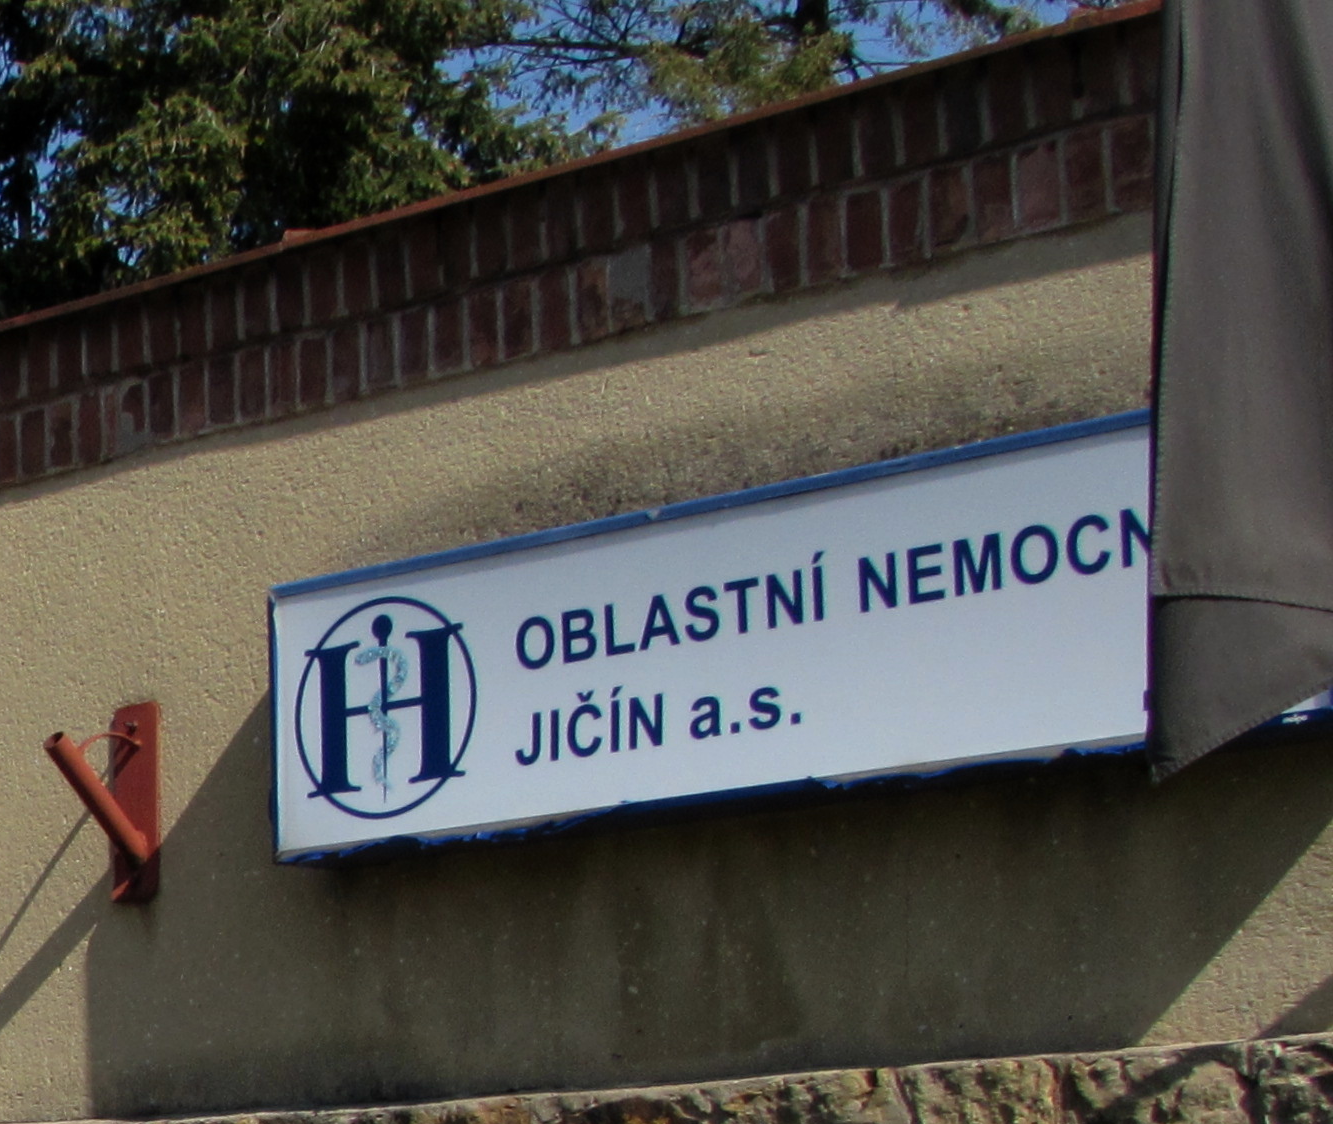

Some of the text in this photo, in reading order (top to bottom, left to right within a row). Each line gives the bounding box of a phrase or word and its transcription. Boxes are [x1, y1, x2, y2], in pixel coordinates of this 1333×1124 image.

[515, 549, 826, 671] OBLASTNÍ
[515, 685, 803, 767] JIČÍN a.s.
